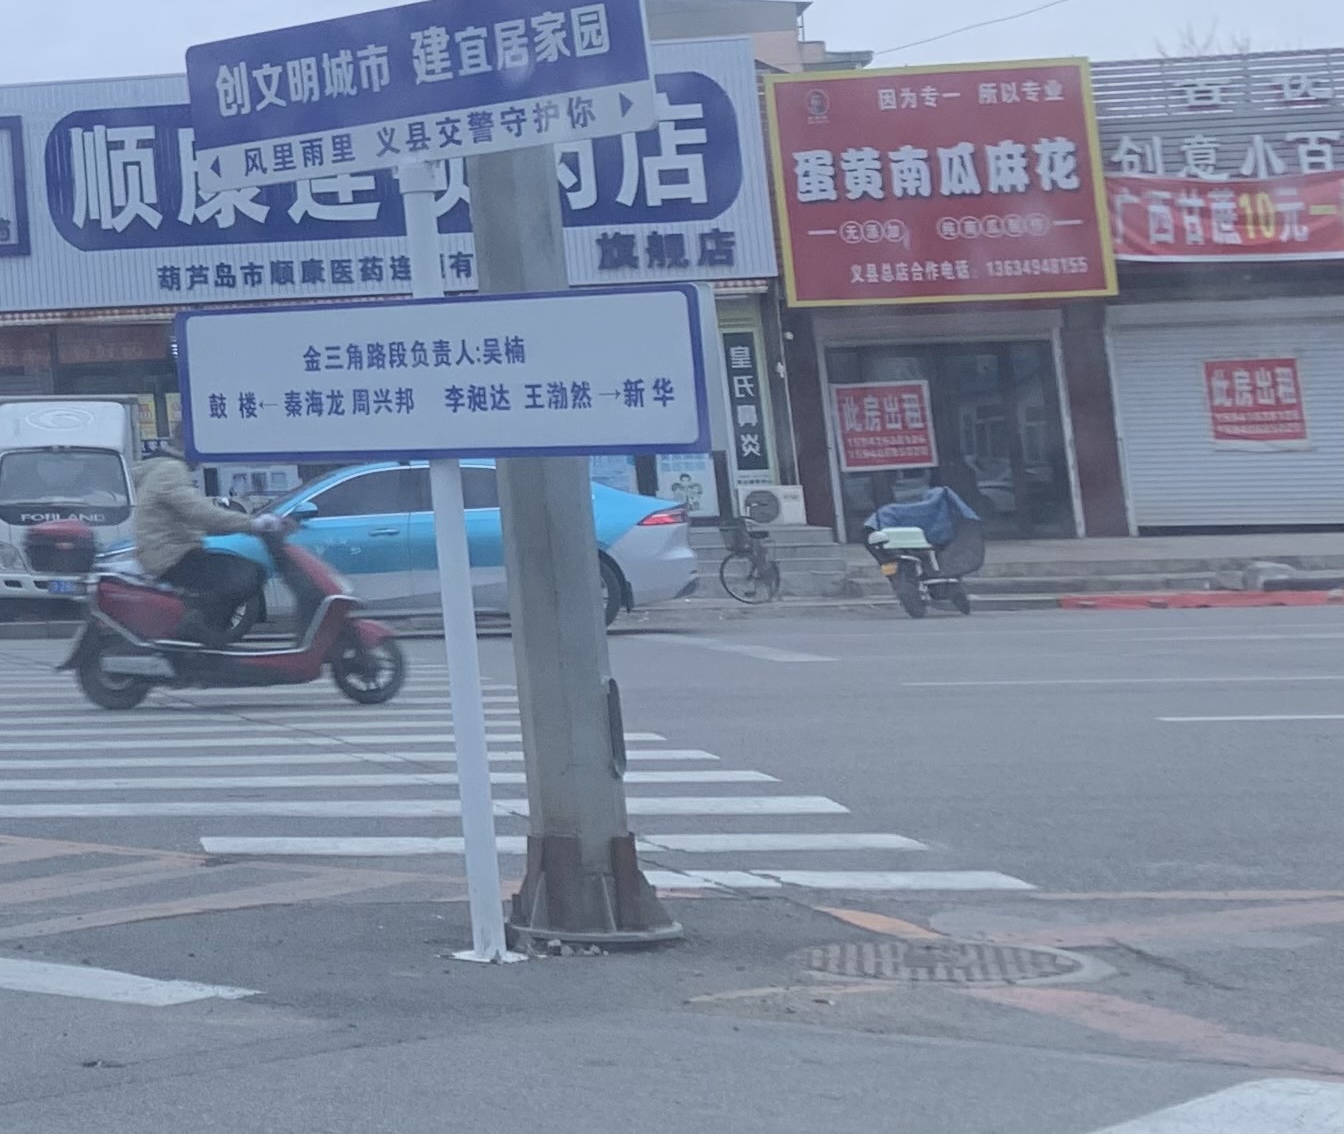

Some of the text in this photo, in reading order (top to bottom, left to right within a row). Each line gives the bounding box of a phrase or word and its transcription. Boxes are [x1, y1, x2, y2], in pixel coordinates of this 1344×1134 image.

[214, 3, 610, 118] 创文明城市 建宜居家园
[877, 78, 1065, 111] 因为专一 所以专业
[244, 96, 596, 176] 风里雨里 义县交警守护你
[70, 92, 708, 234] 顺康店
[792, 135, 1081, 204] 蛋黄南瓜麻花
[157, 251, 475, 291] 葫芦岛市顺康医药连有
[596, 228, 736, 271] 旗舰店
[302, 335, 526, 372] 金三角路段负责人:吴楠
[208, 390, 258, 420] 鼓楼
[283, 388, 345, 418] 秦海龙
[351, 385, 416, 416] 周兴邦
[523, 380, 594, 410] 王渤然
[622, 376, 675, 409] 新华
[20, 512, 106, 523] FORLAND
